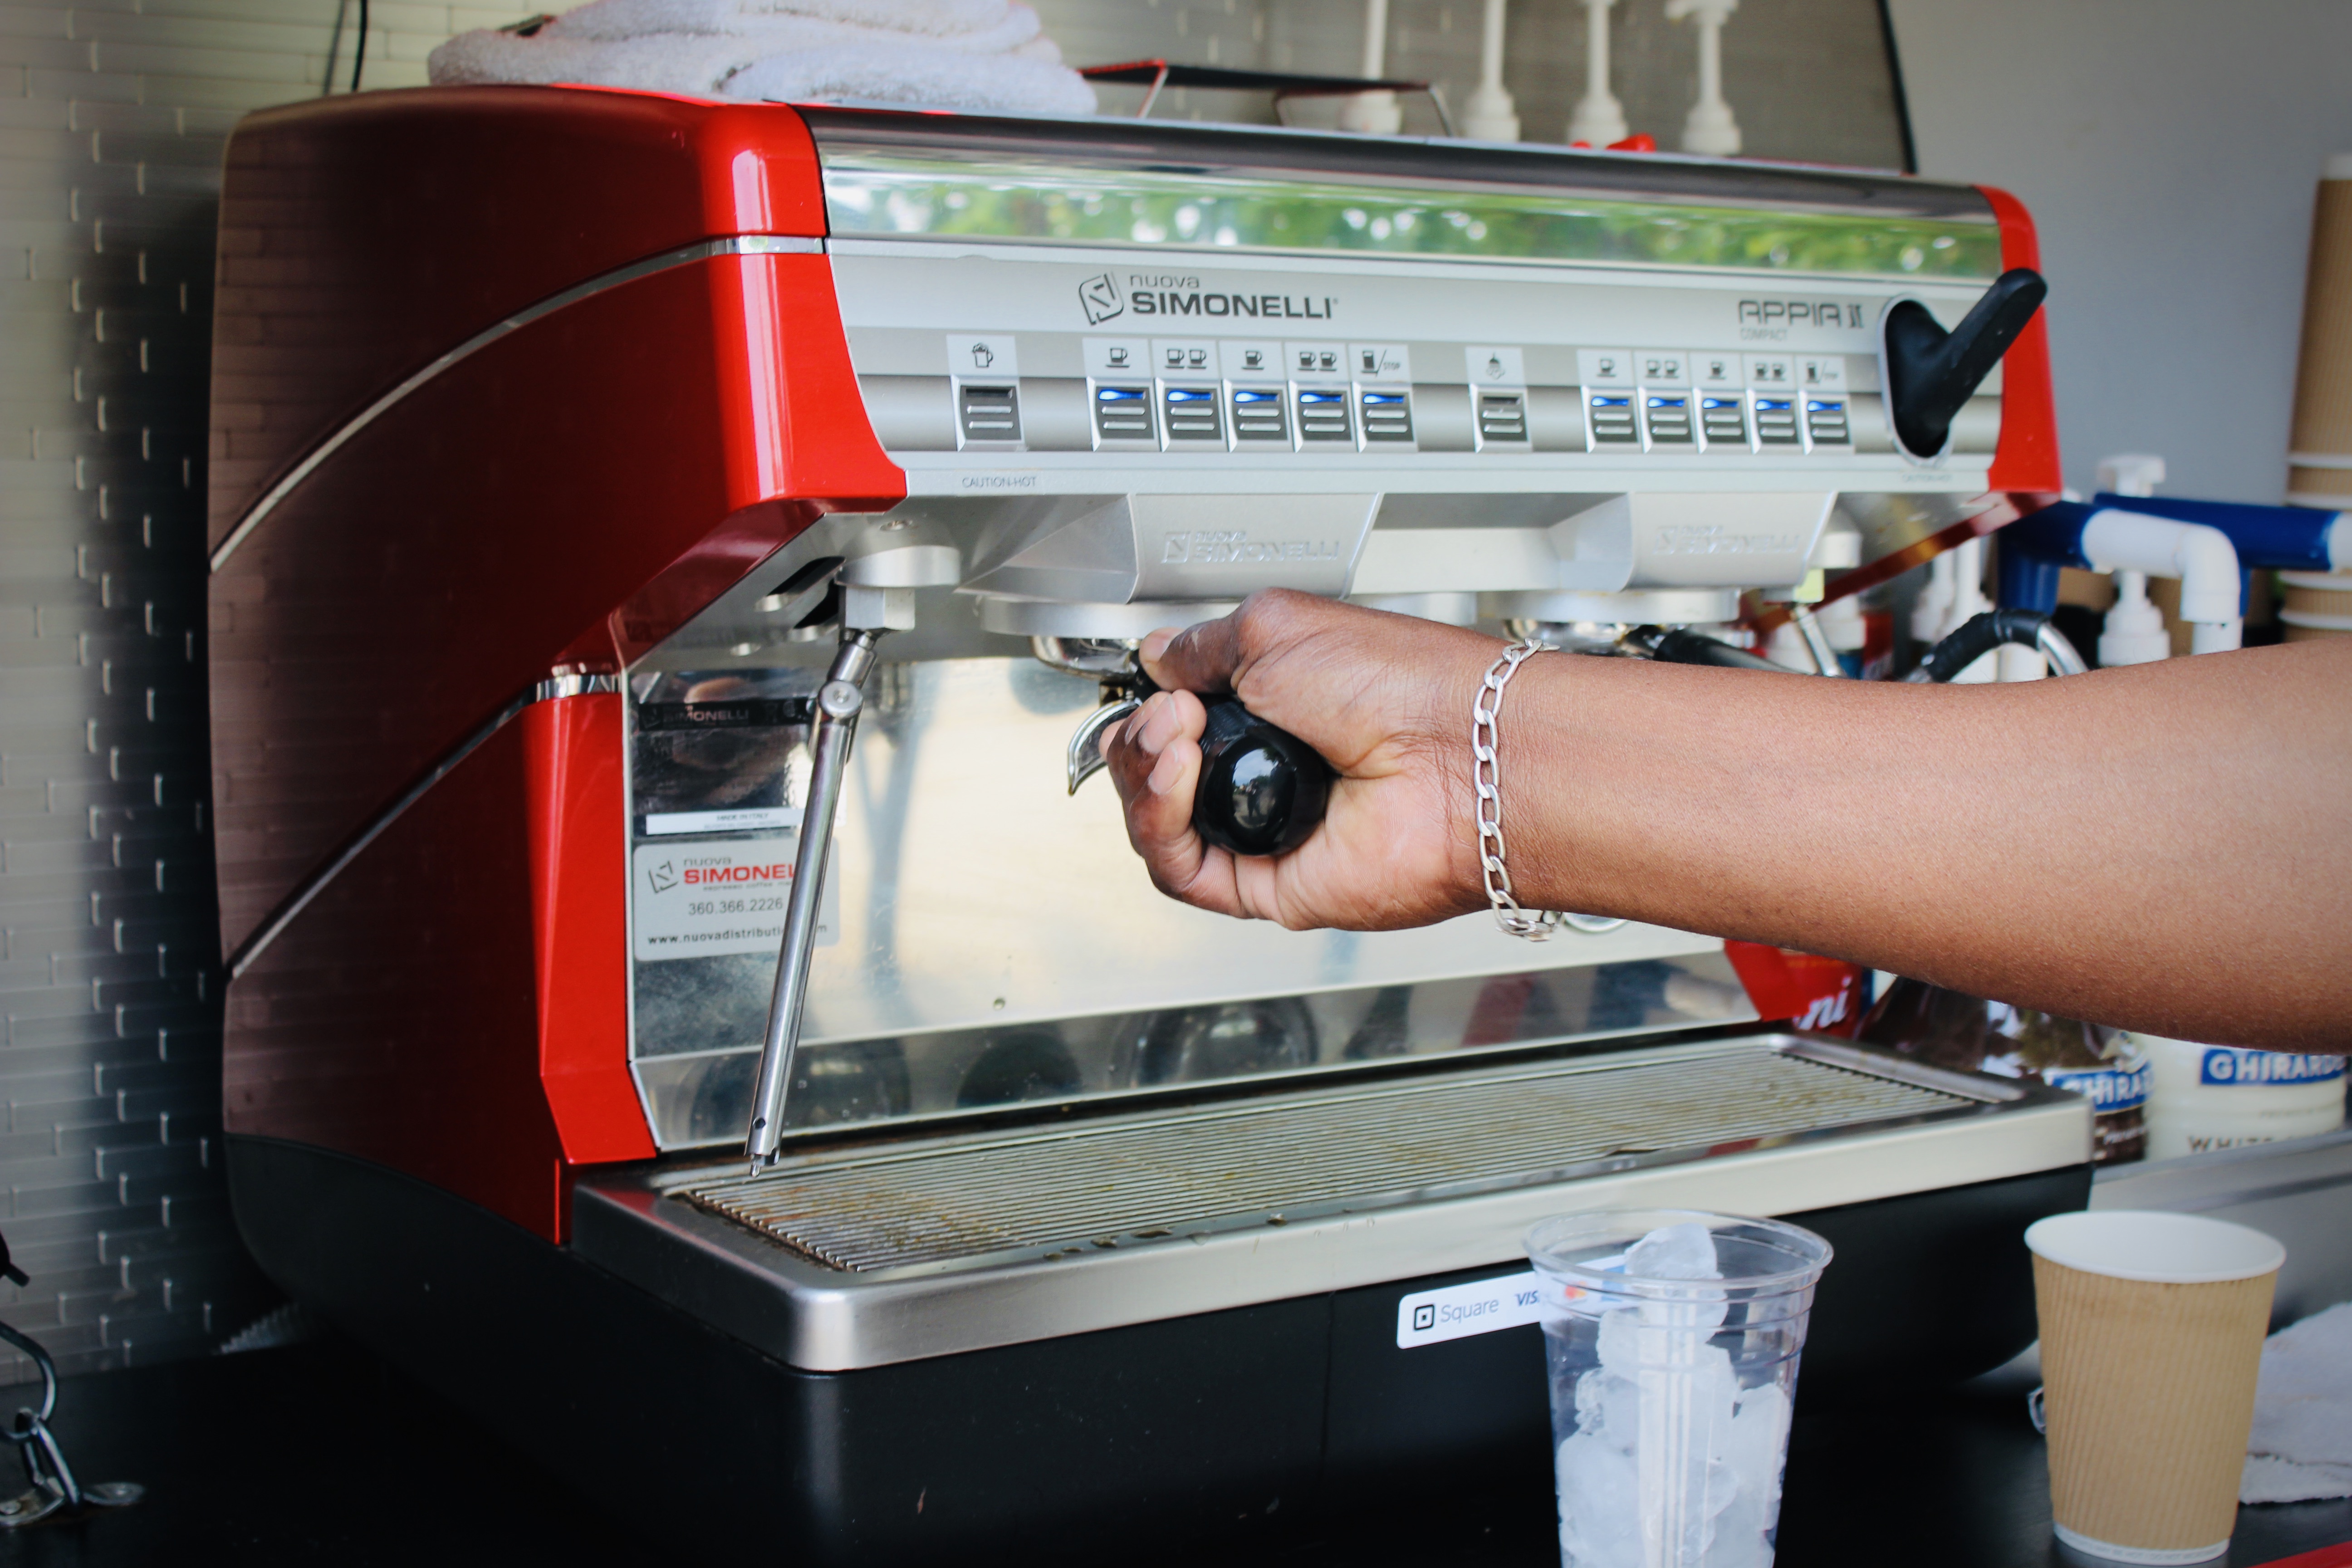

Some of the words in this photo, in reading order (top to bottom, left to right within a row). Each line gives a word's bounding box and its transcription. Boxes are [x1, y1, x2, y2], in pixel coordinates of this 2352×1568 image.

[1130, 274, 1199, 288] nuova
[1739, 300, 1841, 327] APPIA
[1740, 328, 1788, 341] COMPACT
[1195, 531, 1246, 542] nuova
[1192, 542, 1341, 561] SIMONELLI
[684, 857, 732, 867] nuova
[684, 864, 795, 884] SIMONEL
[688, 897, 784, 917] 360.366.2226
[1440, 1296, 1498, 1323] Square
[1516, 1290, 1541, 1307] VIS
